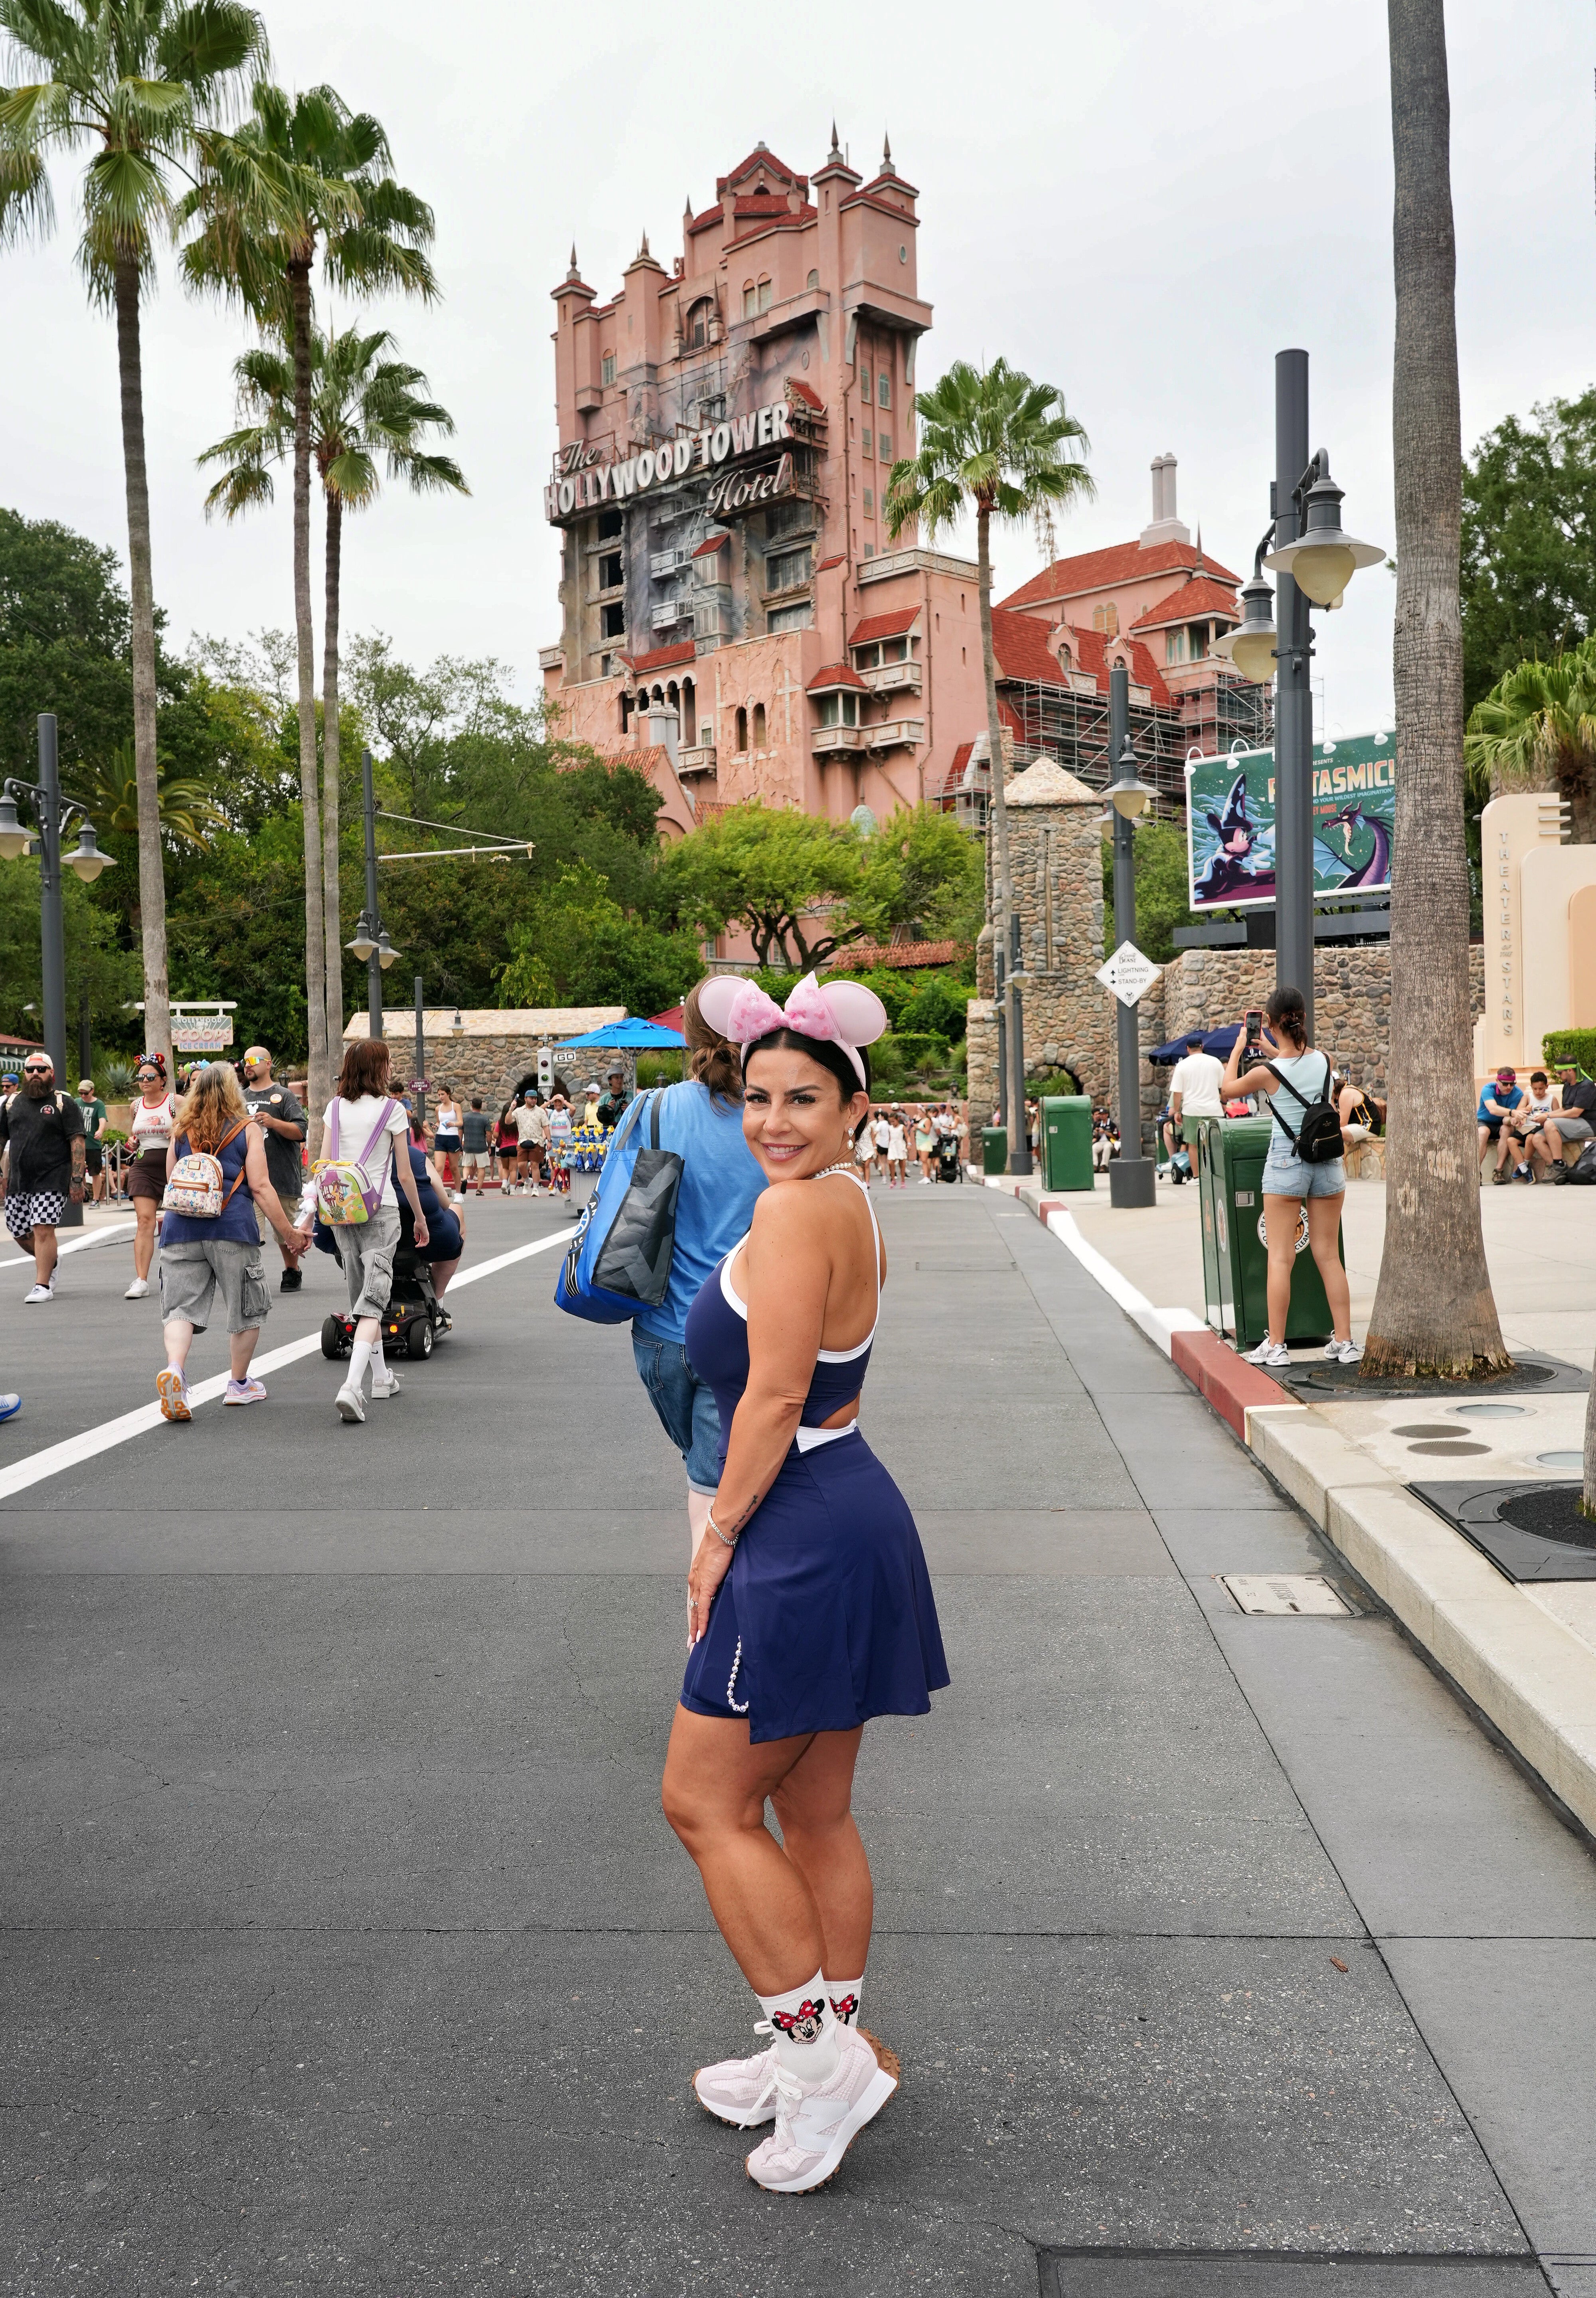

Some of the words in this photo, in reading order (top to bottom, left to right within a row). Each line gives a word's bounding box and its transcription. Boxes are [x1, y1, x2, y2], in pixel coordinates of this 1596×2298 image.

[543, 438, 695, 521] HOLLYWOOD
[698, 401, 794, 466] TOWER
[557, 438, 600, 476] The
[705, 452, 793, 517] Hotel
[1320, 804, 1337, 815] MOUSE
[1499, 832, 1511, 940] THEATER
[1501, 961, 1513, 1036] STARS
[172, 1028, 230, 1042] SCOOPS
[1295, 1232, 1309, 1250] CLEAN
